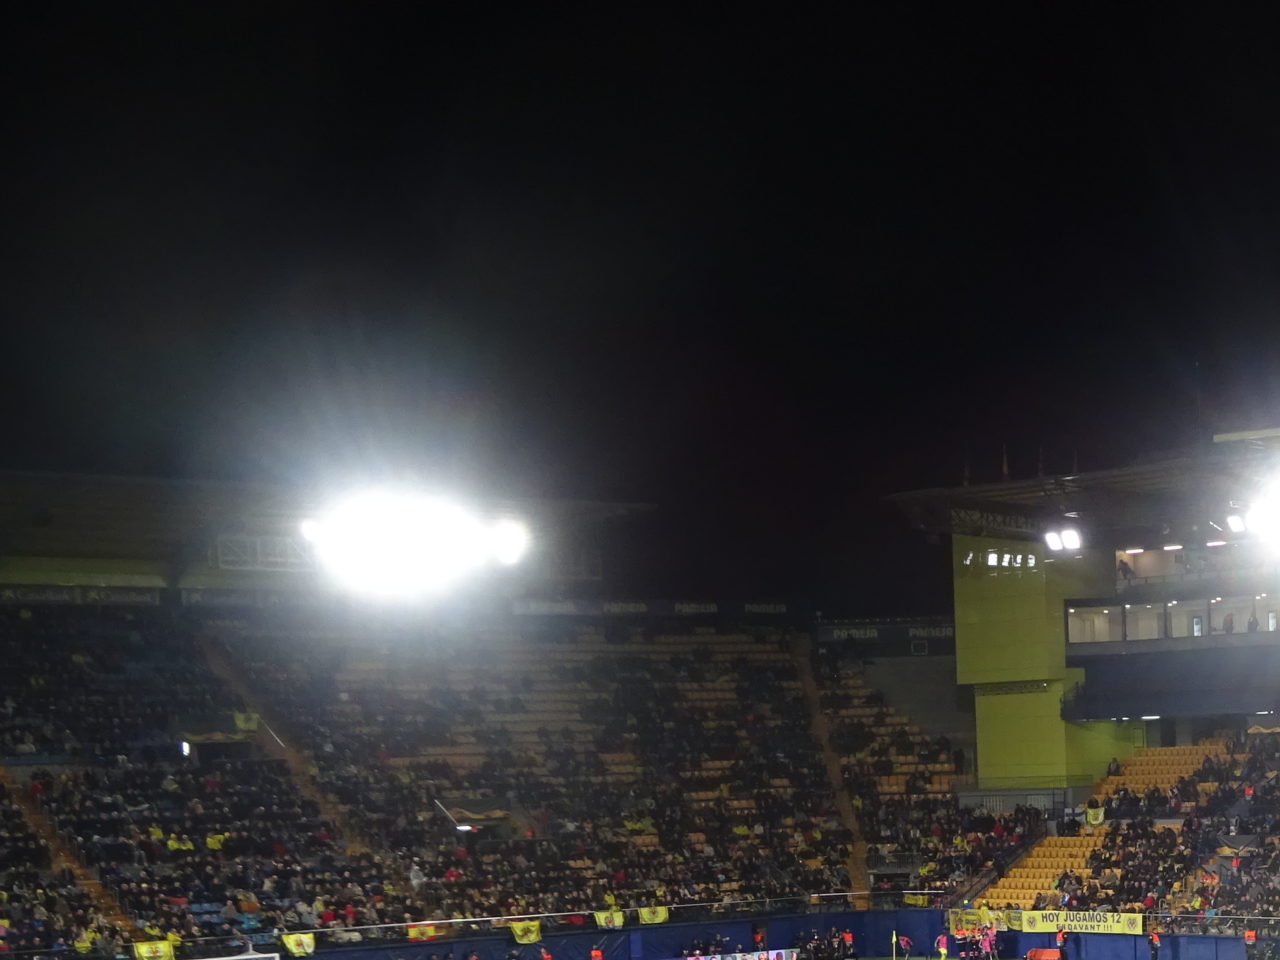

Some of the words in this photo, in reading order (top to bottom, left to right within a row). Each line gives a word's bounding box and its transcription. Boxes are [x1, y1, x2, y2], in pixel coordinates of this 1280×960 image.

[1041, 912, 1060, 922] HOY
[1064, 912, 1108, 923] JUGAMOS
[1111, 913, 1122, 924] 12
